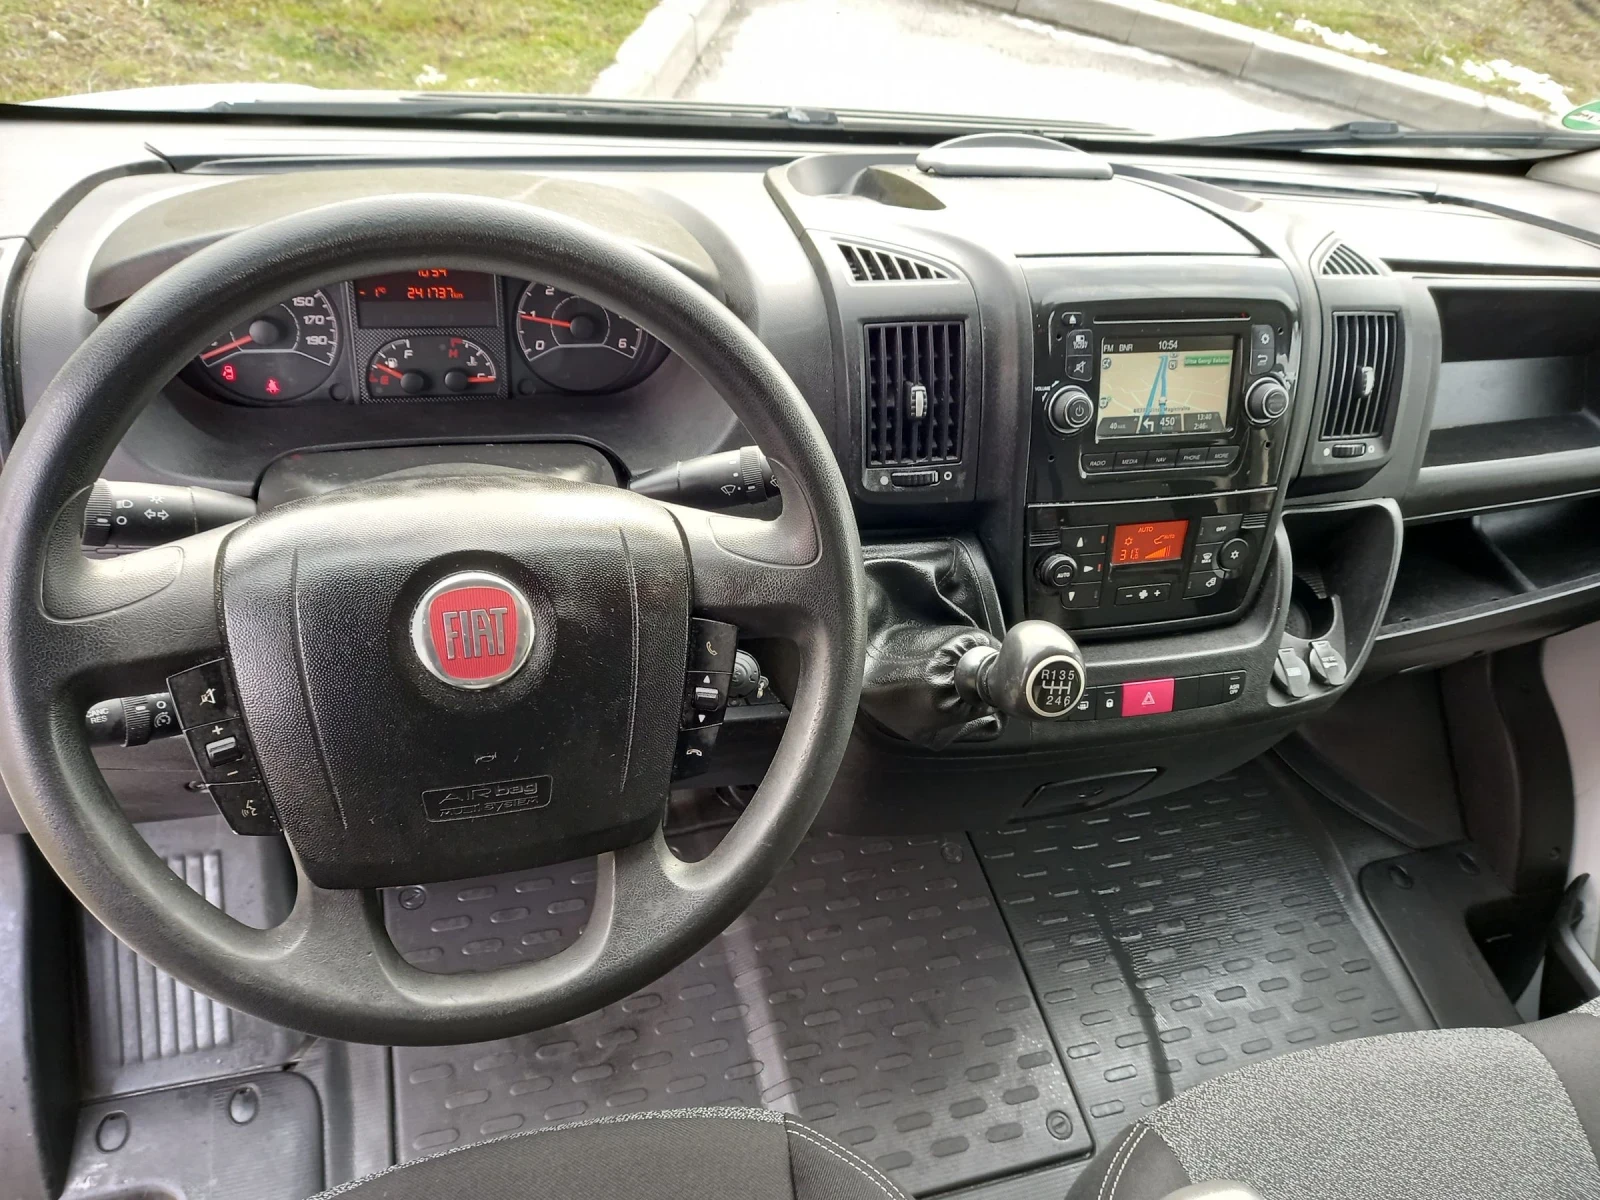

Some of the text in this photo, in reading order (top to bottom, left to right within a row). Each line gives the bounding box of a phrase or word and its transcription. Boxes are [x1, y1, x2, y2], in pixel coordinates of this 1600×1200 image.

[545, 285, 555, 296] 2
[292, 296, 315, 307] 150
[303, 314, 325, 325] 170
[305, 335, 328, 345] 190
[535, 340, 545, 351] 0
[618, 338, 628, 349] 6
[1103, 344, 1114, 352] FM
[1158, 340, 1178, 350] 10:54
[404, 349, 414, 359] F
[1159, 416, 1175, 426] 450
[442, 607, 508, 660] FIAT
[90, 715, 108, 725] RES
